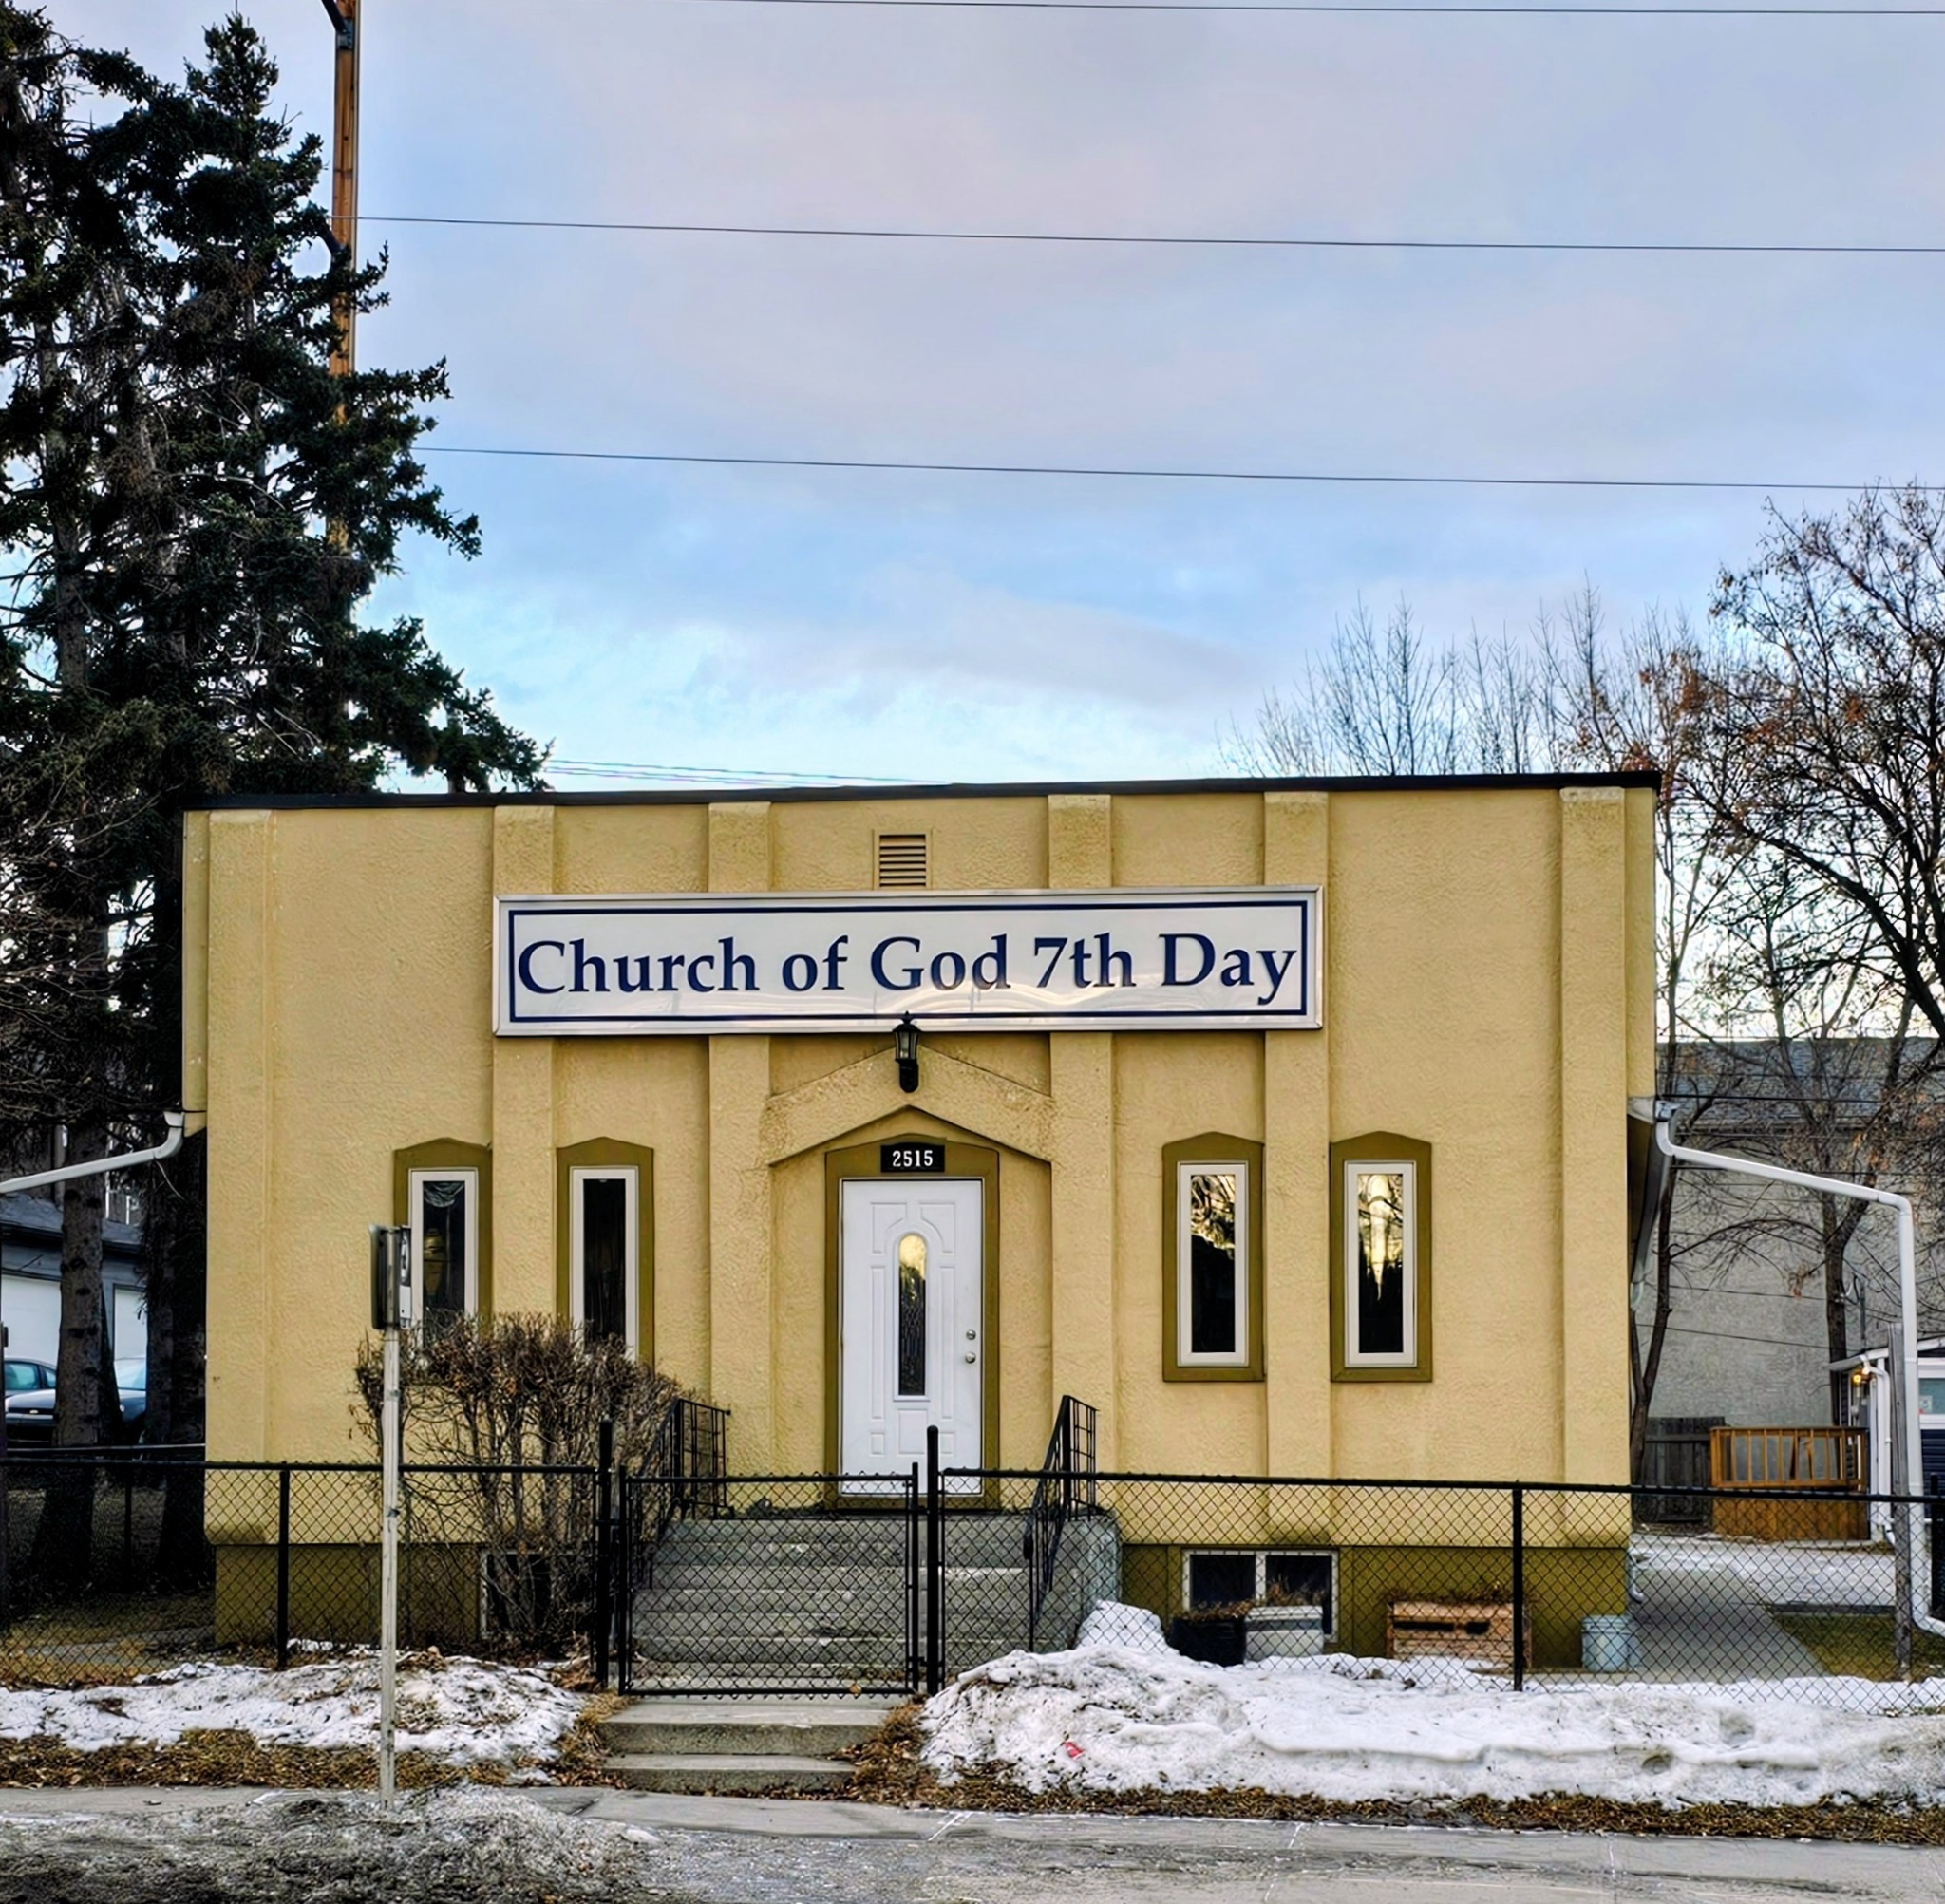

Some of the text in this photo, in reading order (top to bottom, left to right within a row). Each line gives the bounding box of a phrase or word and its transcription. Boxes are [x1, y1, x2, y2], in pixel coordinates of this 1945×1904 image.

[518, 932, 1297, 1006] Church of God 7th Day
[892, 1149, 934, 1167] 2515
